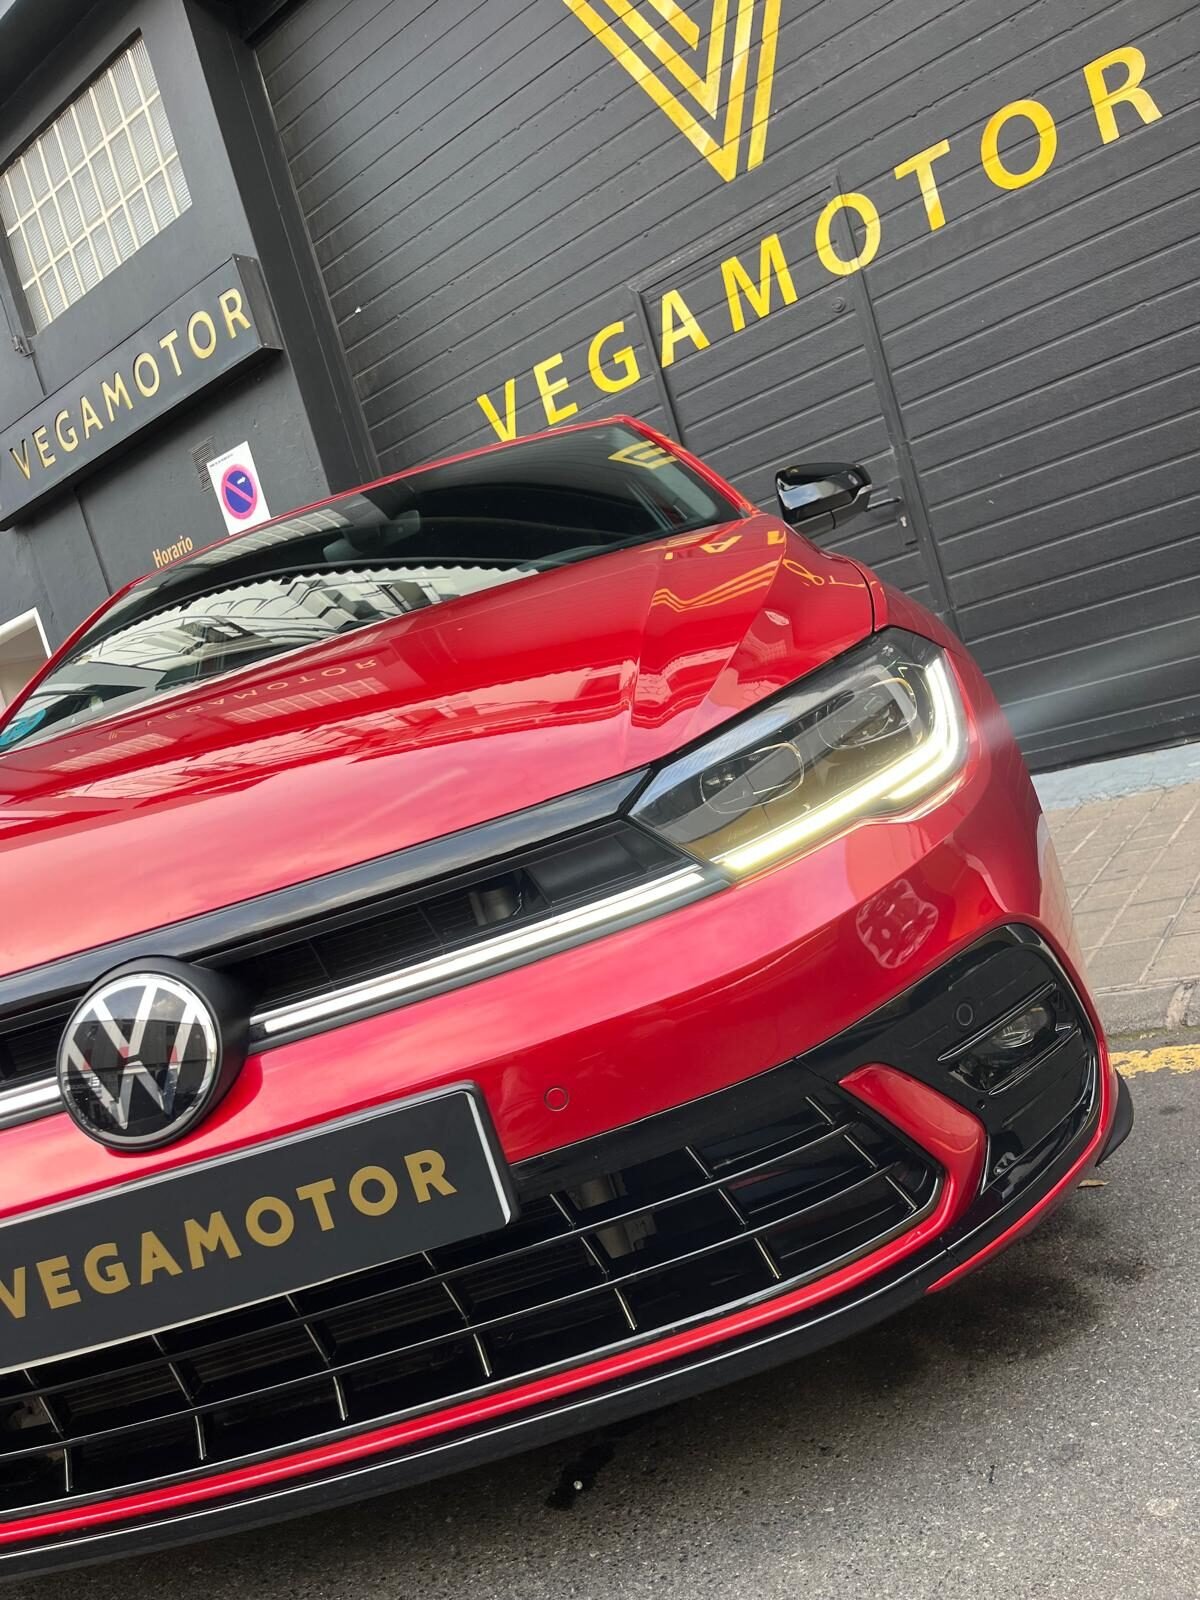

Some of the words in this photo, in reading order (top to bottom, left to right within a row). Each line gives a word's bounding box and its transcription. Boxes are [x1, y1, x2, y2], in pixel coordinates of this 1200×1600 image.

[477, 46, 1162, 442] VEGAMOTOR
[9, 288, 251, 480] VEGAMOTOR
[152, 535, 193, 568] Horario
[0, 1149, 458, 1319] VEGAMOTOR
